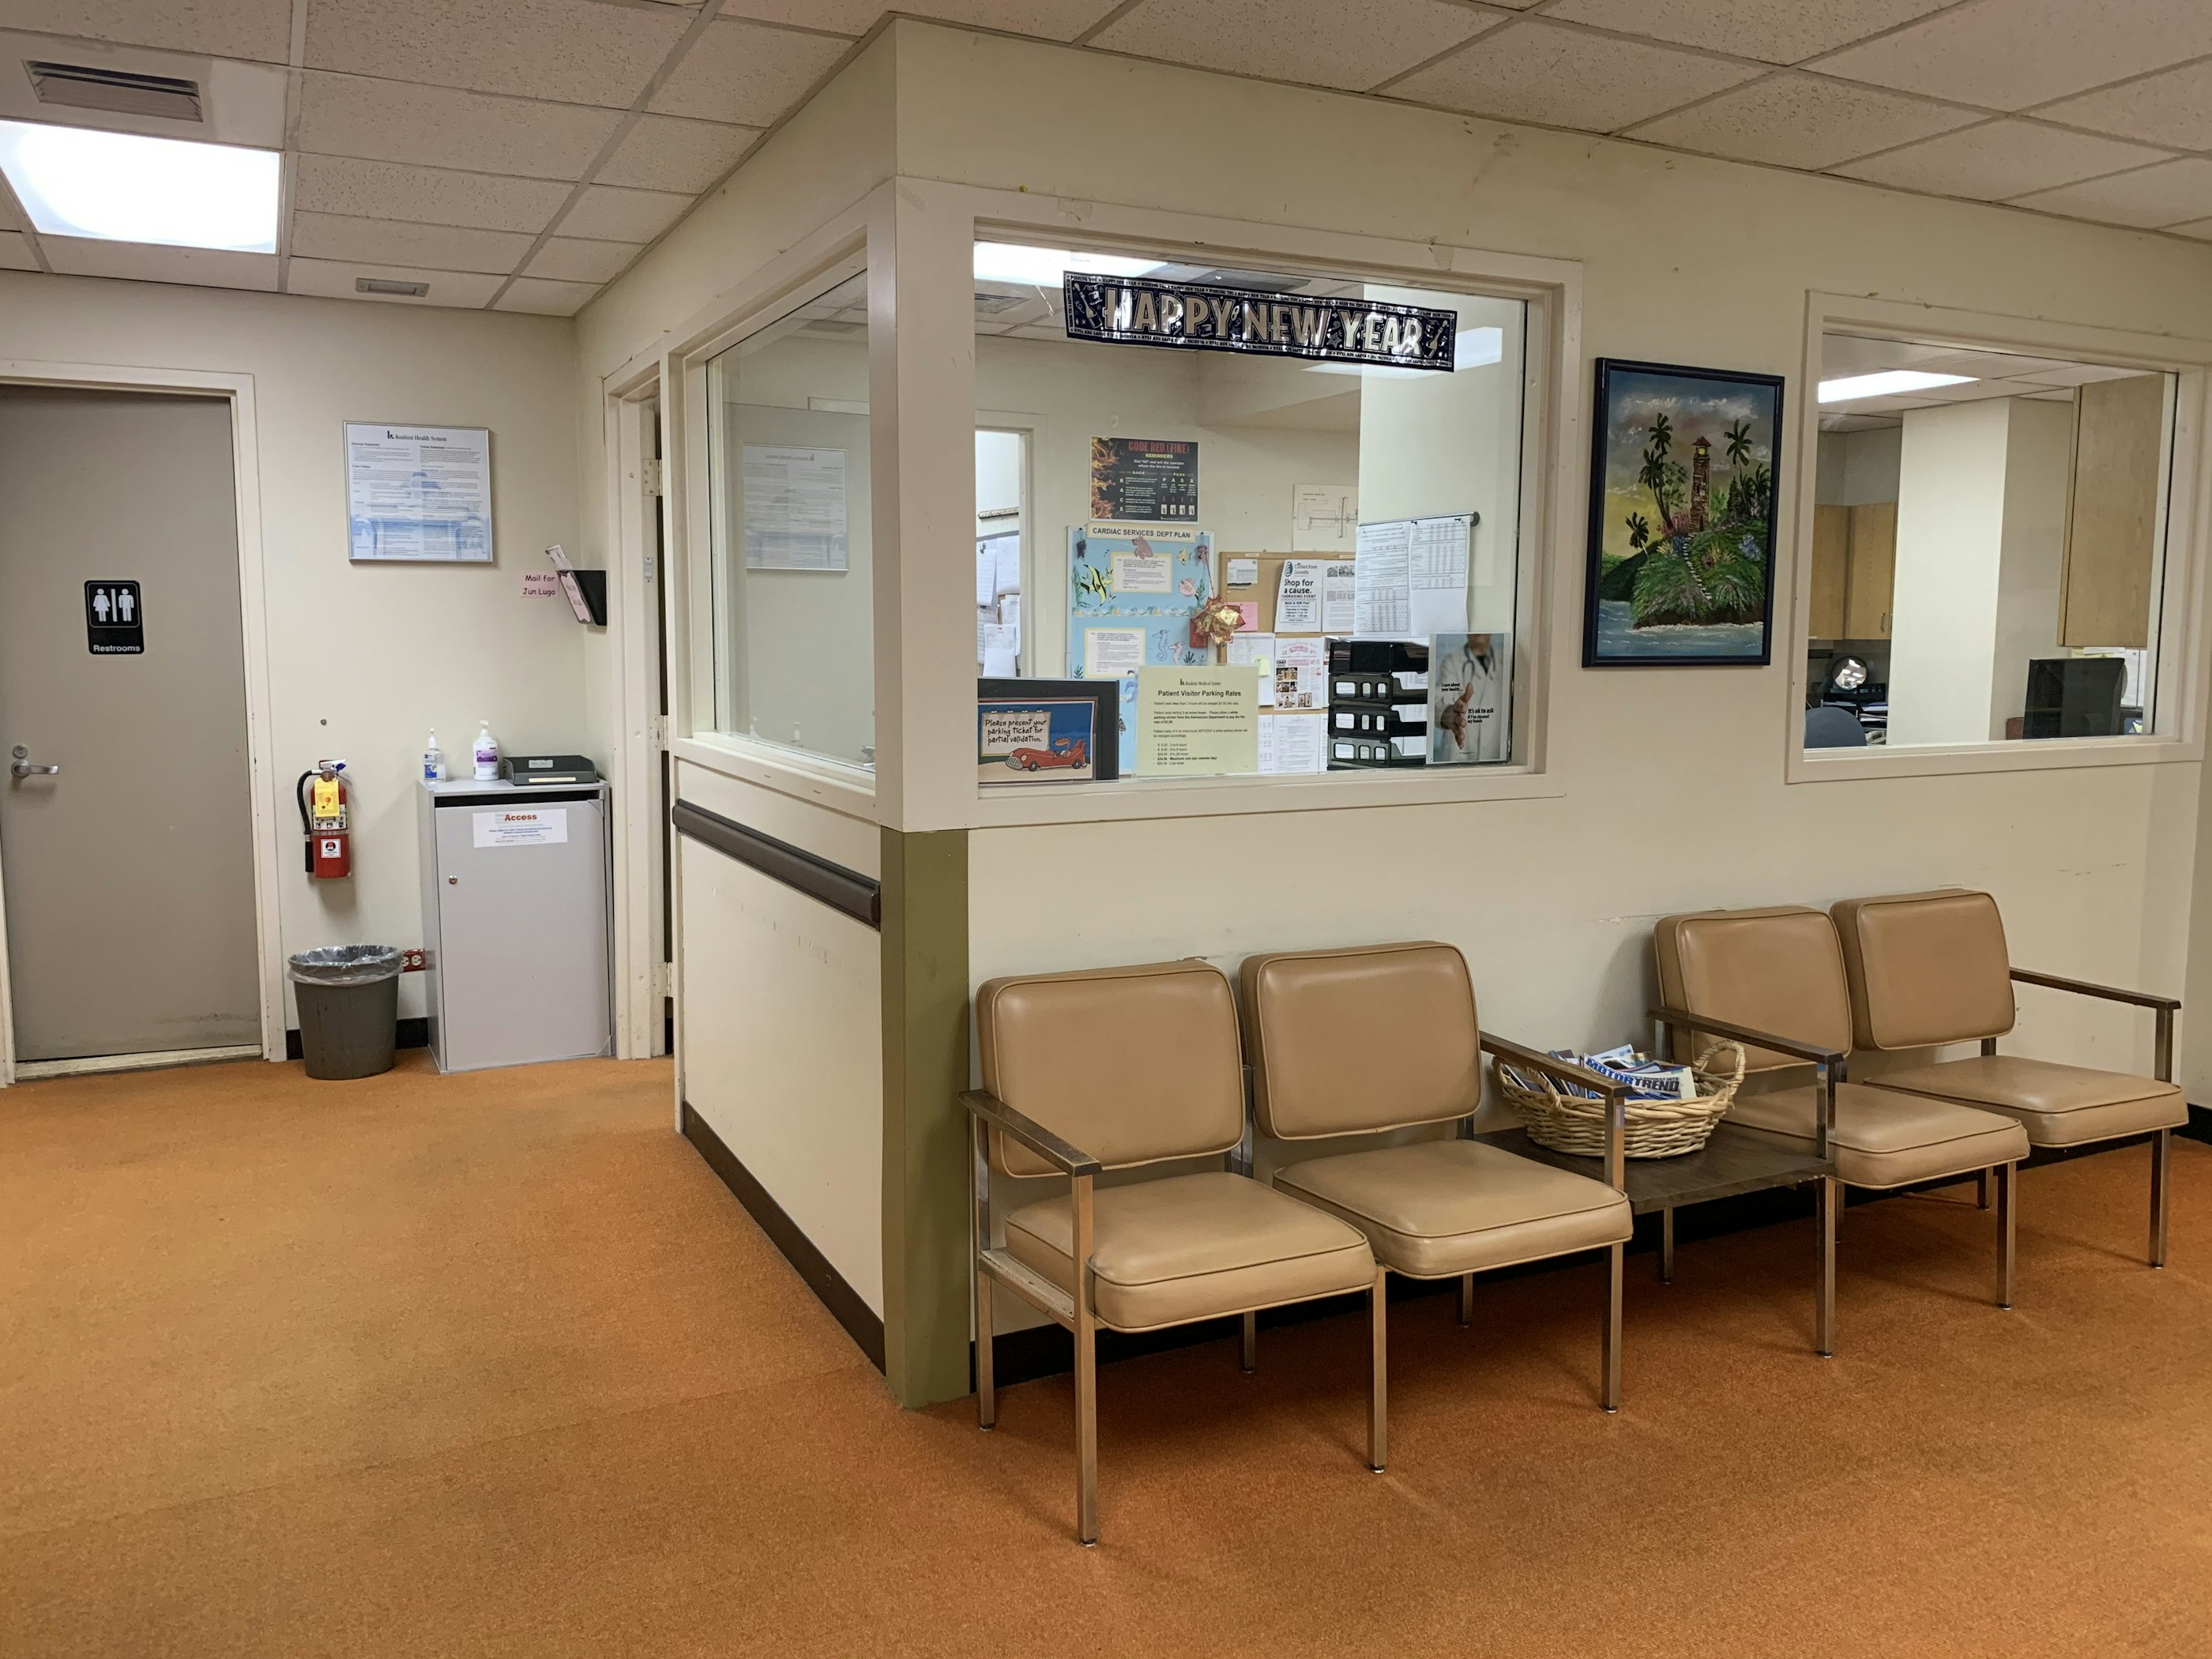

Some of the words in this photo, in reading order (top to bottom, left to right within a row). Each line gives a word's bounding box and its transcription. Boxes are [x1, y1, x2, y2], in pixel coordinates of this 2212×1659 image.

[1103, 288, 1235, 339] HAPPY
[1243, 300, 1331, 347] NEW
[1337, 309, 1423, 356] YEAR
[1128, 442, 1149, 452] CODE
[1150, 442, 1165, 452] RED
[1167, 442, 1190, 454] (FIRE)
[1008, 718, 1033, 728] present
[988, 728, 1010, 737] parking
[988, 735, 1009, 746] partial
[1635, 1078, 1680, 1092] TREND
